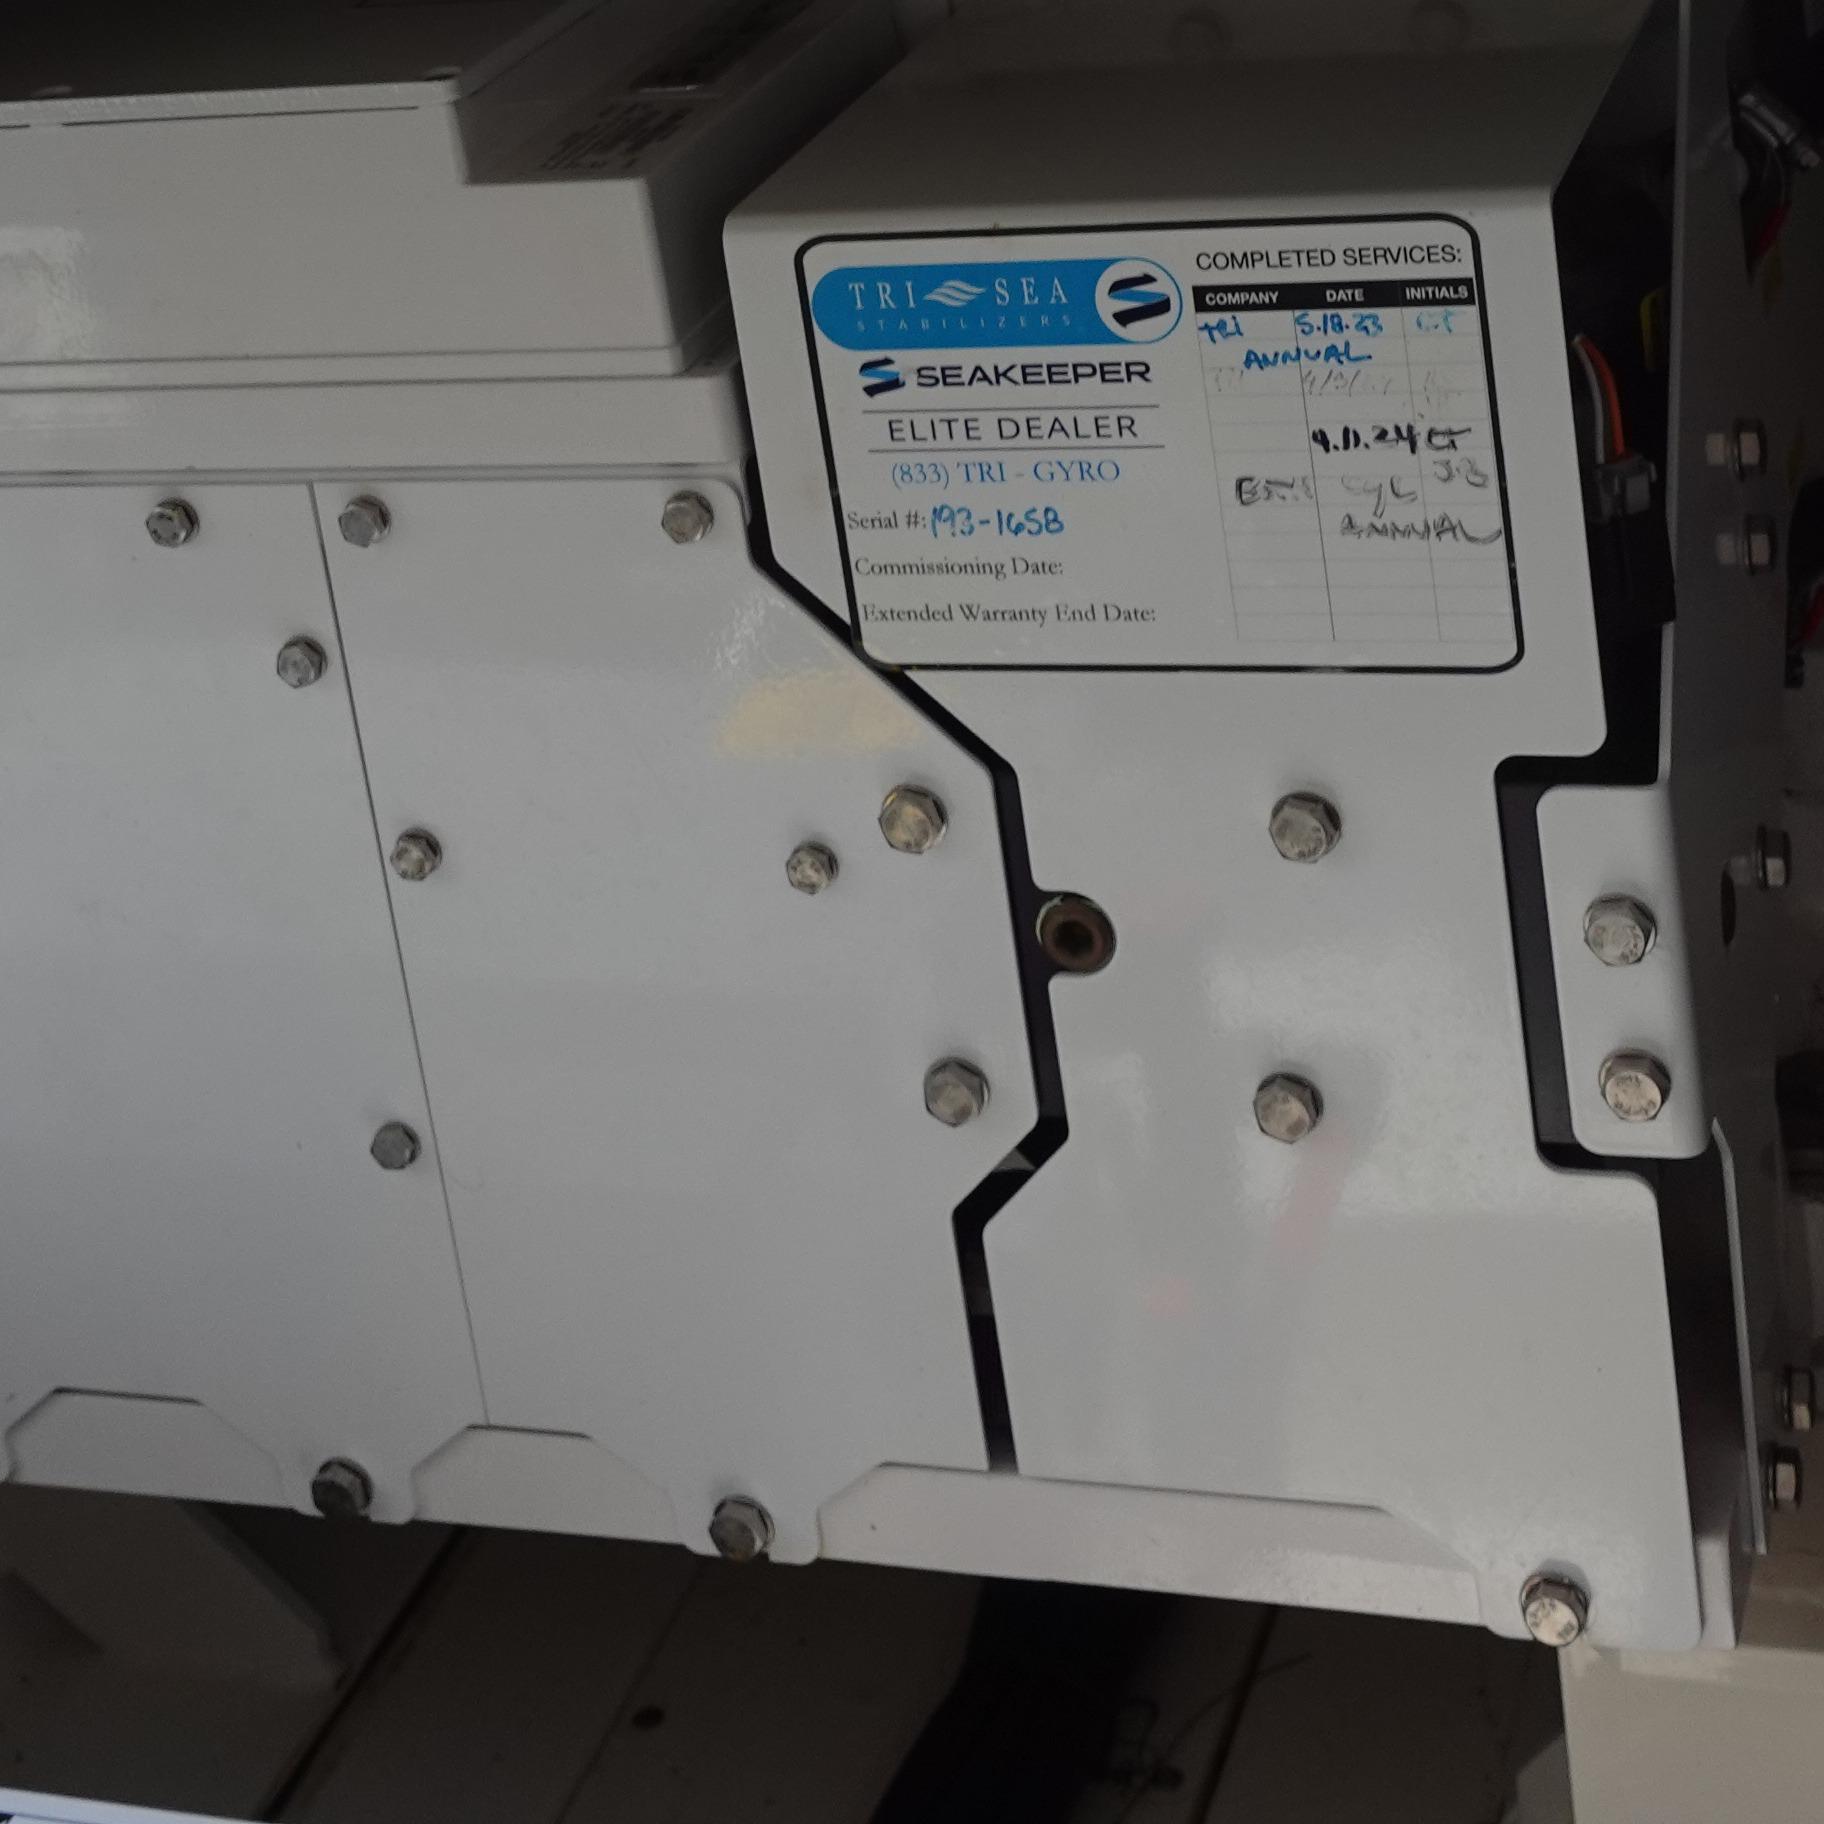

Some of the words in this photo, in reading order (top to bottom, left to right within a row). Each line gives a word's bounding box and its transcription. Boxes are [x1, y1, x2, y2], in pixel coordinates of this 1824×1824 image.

[1195, 248, 1337, 271] COMPLETED
[1342, 244, 1462, 267] SERVICES:
[848, 280, 916, 310] TRI
[994, 275, 1068, 307] SEA
[1205, 291, 1279, 306] COMPANY
[1326, 288, 1365, 303] DATE
[1405, 285, 1468, 300] INITIALS
[857, 314, 1072, 332] STABILIZERS
[1243, 341, 1373, 371] ANNUAL
[916, 360, 1152, 388] SEAKEEPER
[888, 417, 982, 443] ELITE
[997, 414, 1139, 440] DEALER
[891, 462, 950, 490] (833)
[955, 461, 1006, 483] TRI
[1033, 458, 1120, 483] GYRO
[847, 512, 899, 531] Serial
[905, 511, 927, 530] #:
[854, 556, 1006, 580] Commissioning
[1012, 555, 1064, 575] Date:
[863, 603, 952, 623] Extended
[958, 603, 1048, 628] Warranty
[1055, 602, 1097, 622] End
[1103, 602, 1156, 622] Date:
